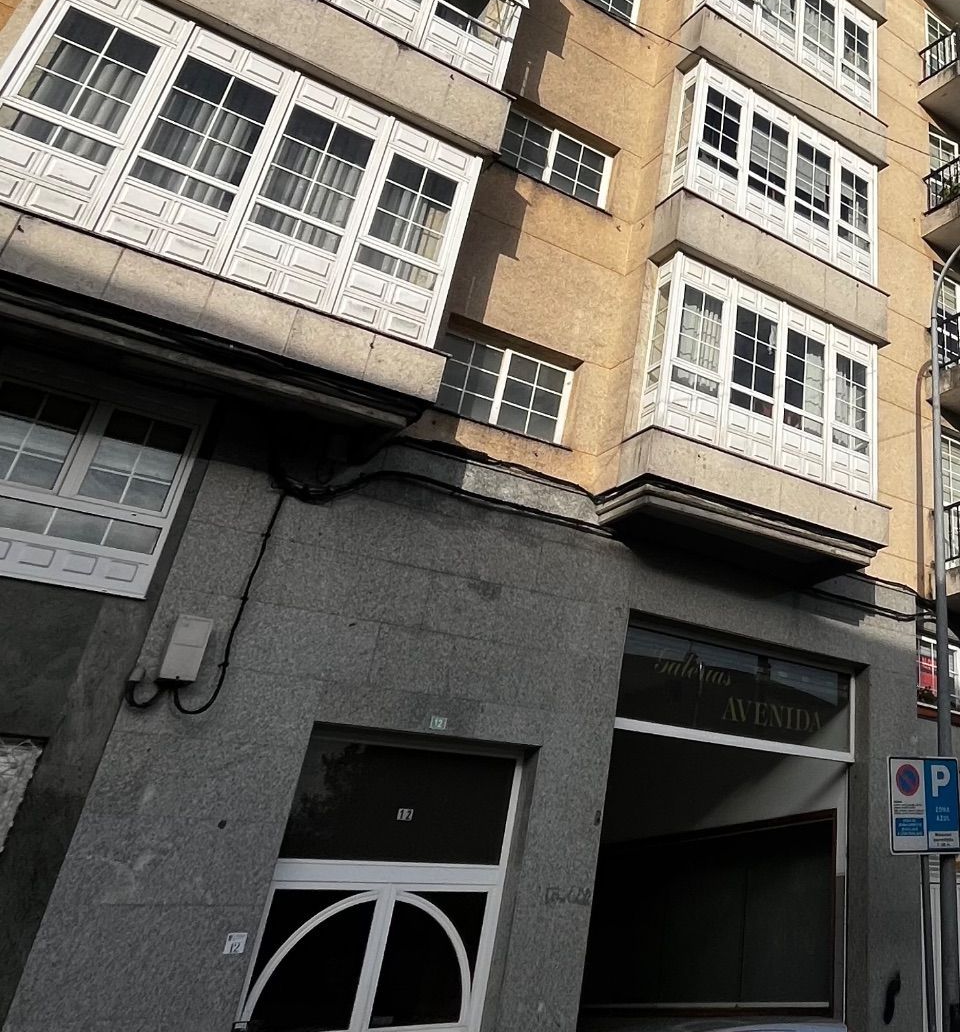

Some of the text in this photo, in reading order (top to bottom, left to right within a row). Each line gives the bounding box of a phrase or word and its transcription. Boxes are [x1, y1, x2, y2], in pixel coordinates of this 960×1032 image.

[721, 696, 823, 733] AVENIDA
[931, 765, 951, 798] P
[400, 809, 411, 820] 12
[230, 943, 241, 953] 12
